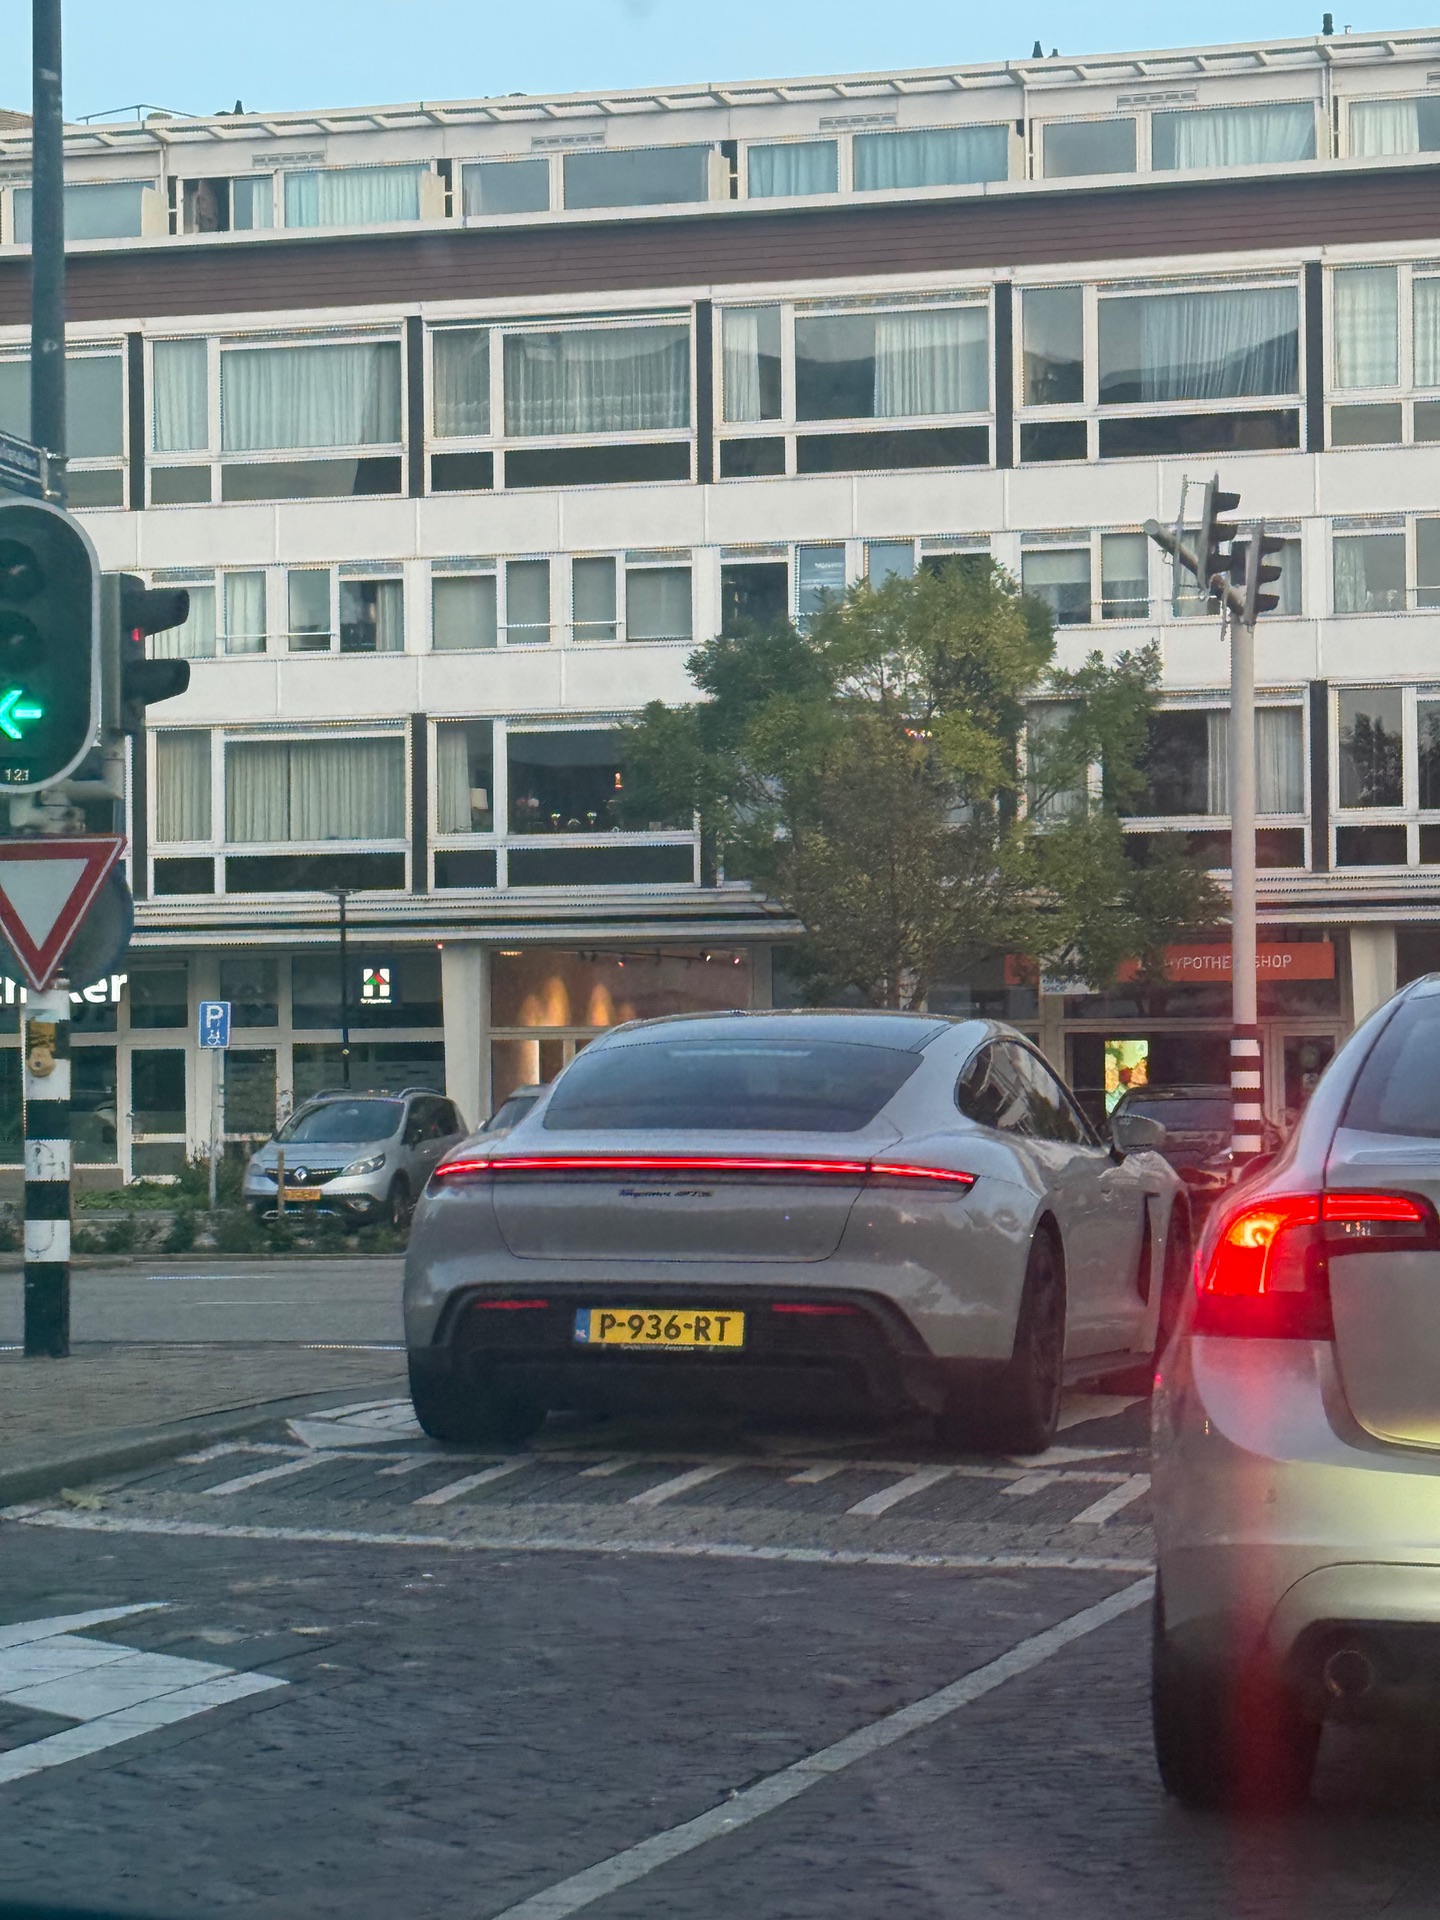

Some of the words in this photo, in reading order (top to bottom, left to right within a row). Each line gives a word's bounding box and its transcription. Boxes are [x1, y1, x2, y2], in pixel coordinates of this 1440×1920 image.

[5, 768, 29, 781] 121
[206, 1005, 223, 1028] P
[600, 1313, 731, 1342] P-936-RT
